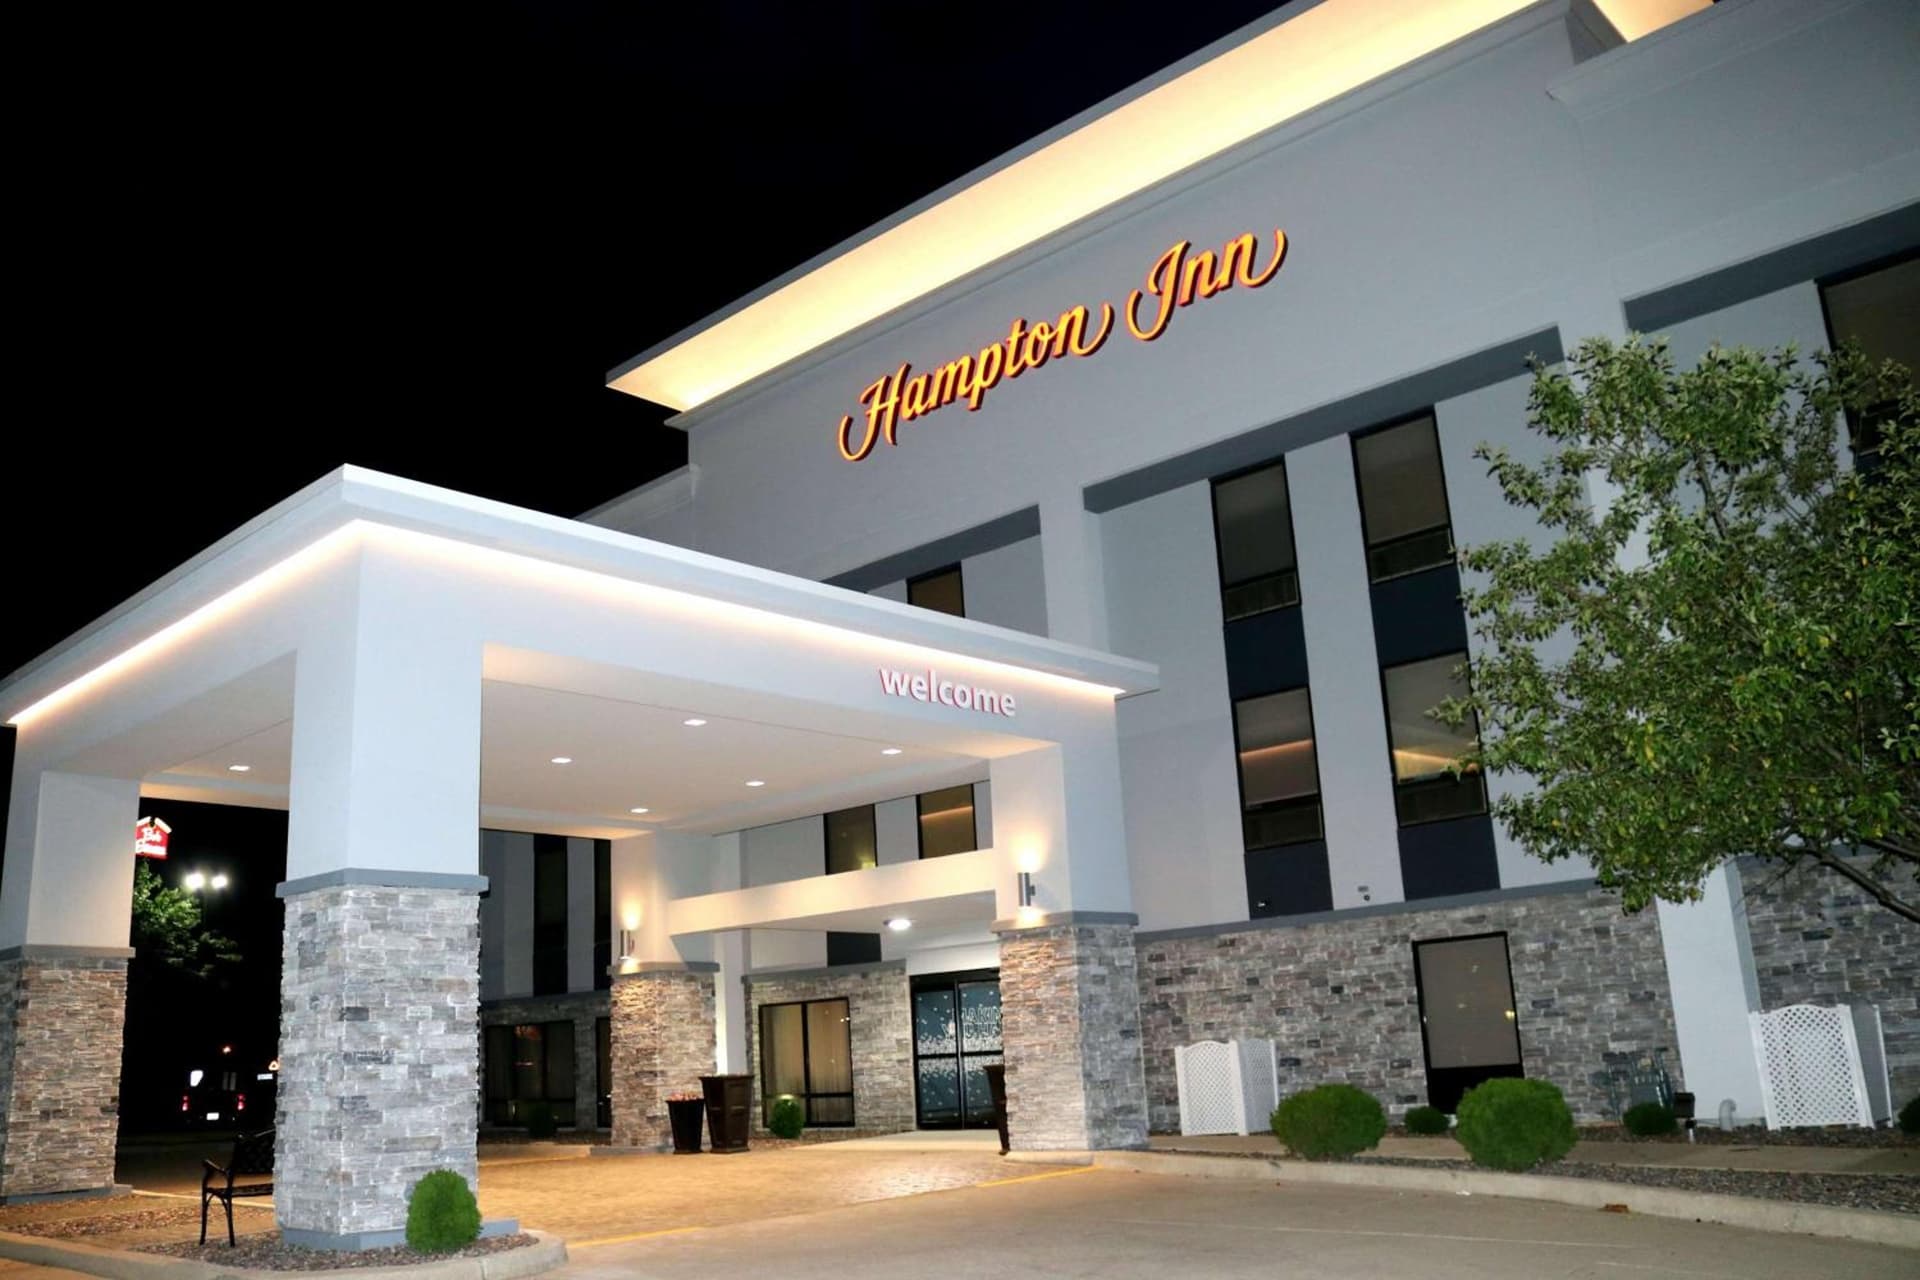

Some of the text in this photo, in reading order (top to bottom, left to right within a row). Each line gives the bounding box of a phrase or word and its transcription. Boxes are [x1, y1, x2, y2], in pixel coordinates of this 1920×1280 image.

[838, 229, 1288, 462] Hampton Inn
[879, 667, 1016, 716] welcome
